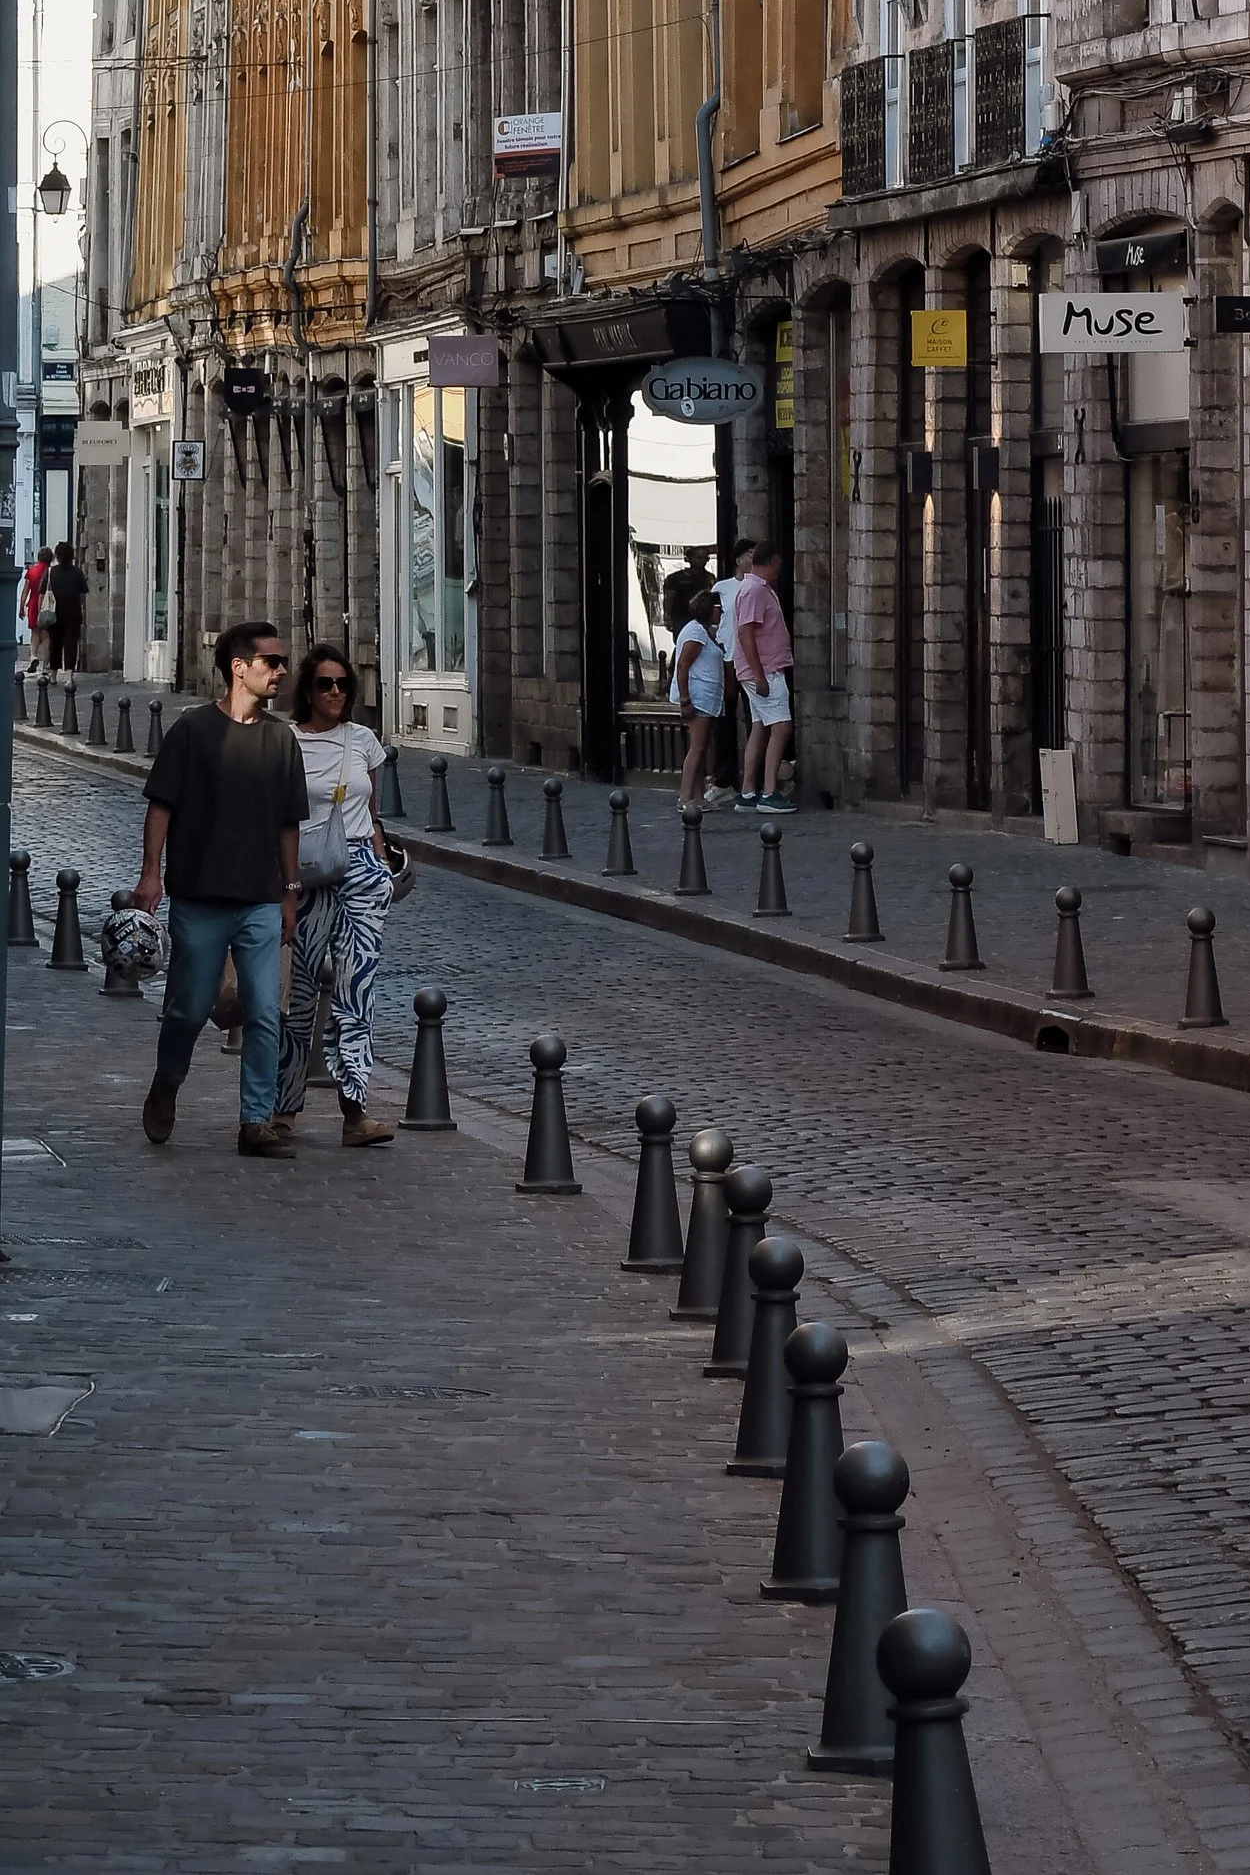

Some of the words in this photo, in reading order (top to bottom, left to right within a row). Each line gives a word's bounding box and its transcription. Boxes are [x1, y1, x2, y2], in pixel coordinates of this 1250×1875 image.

[513, 117, 544, 126] ORANGE
[513, 125, 545, 135] FENÊTRE
[1125, 242, 1146, 266] Muse
[1062, 301, 1164, 337] Muse
[433, 352, 494, 366] VANCO
[648, 376, 757, 401] Gabiano
